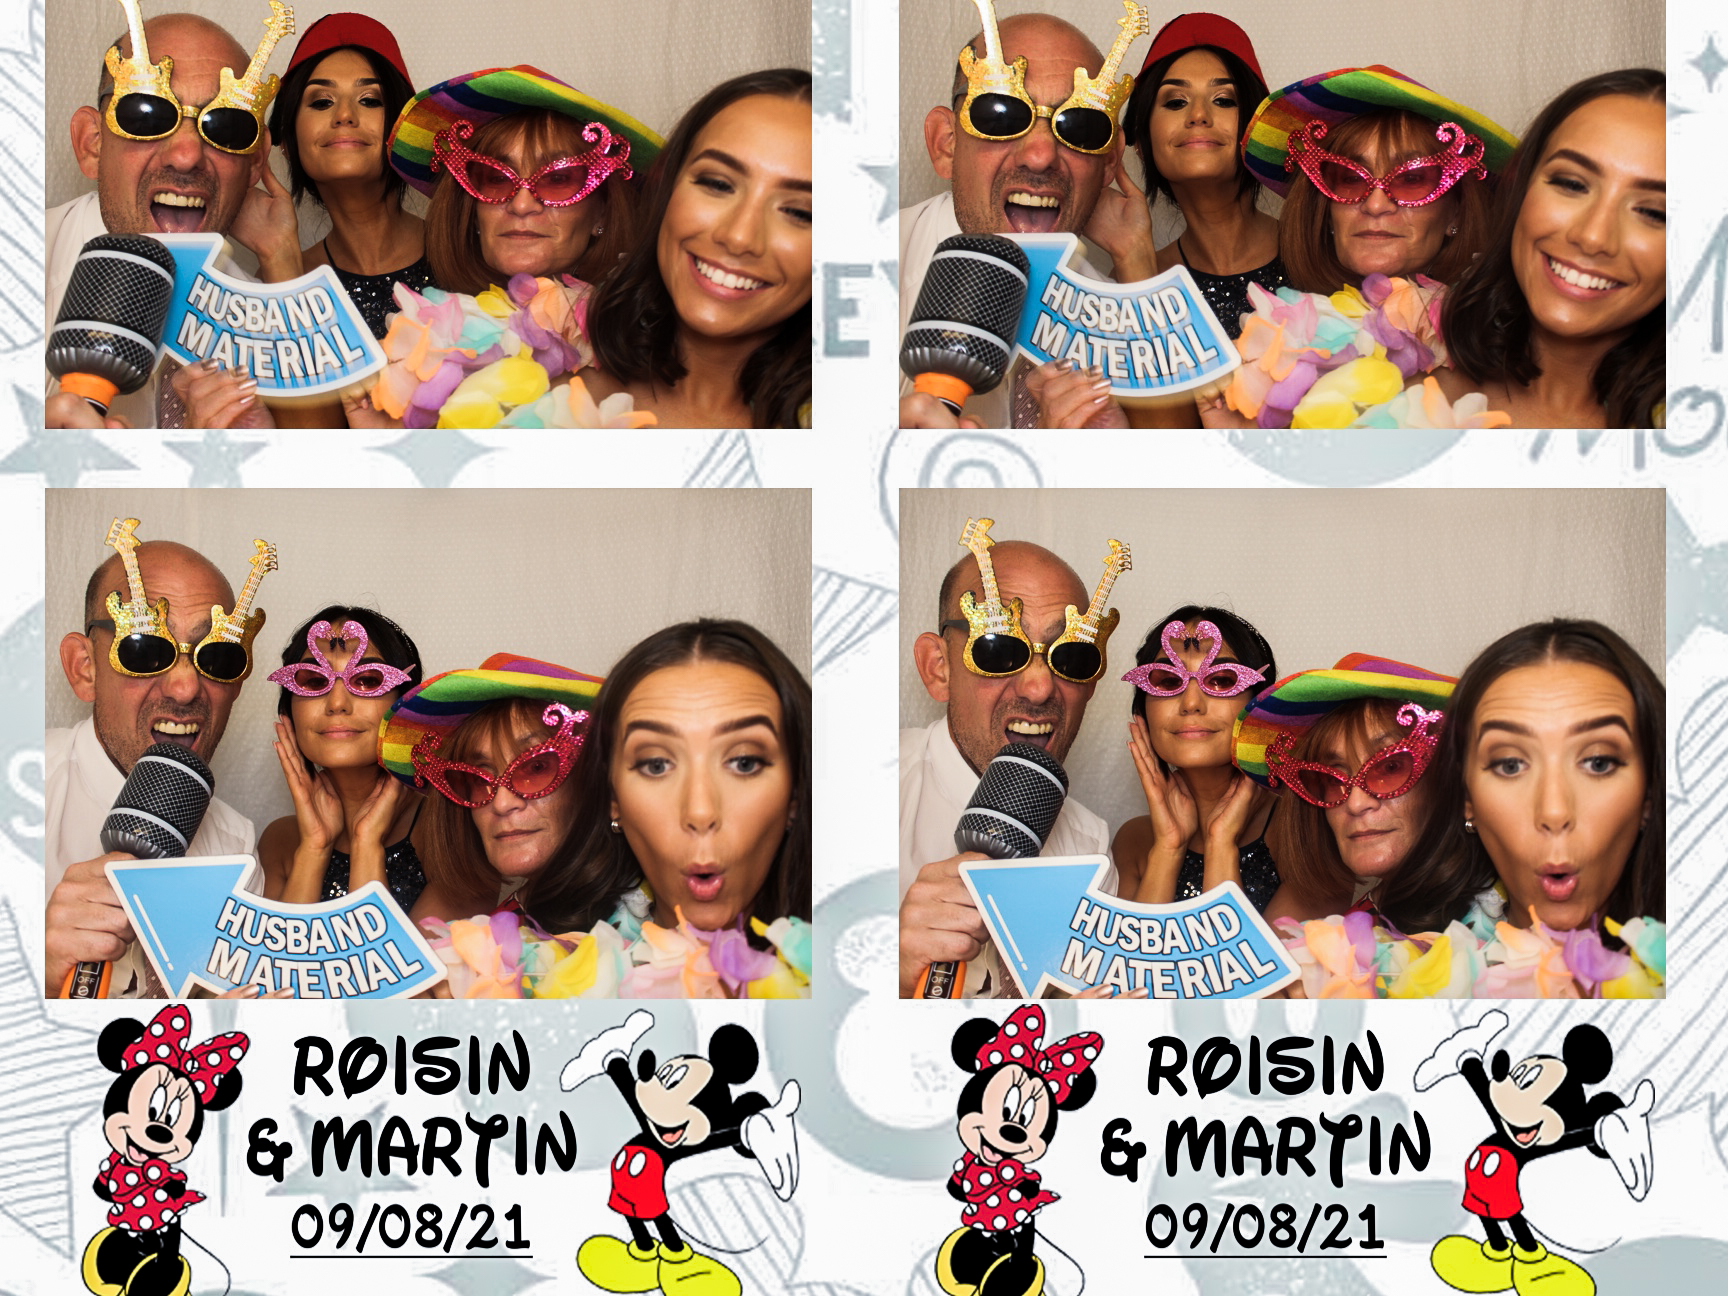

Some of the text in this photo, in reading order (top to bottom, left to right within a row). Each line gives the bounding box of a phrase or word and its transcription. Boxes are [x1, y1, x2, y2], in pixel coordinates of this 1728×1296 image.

[186, 272, 335, 334] HUSBAND
[1040, 272, 1189, 334] HUSBAND
[175, 310, 366, 380] MATERIAL
[1029, 310, 1220, 380] MATERIAL
[215, 896, 389, 956] HUSBAND
[1069, 896, 1243, 956] HUSBAND
[77, 975, 96, 985] OFF
[206, 936, 425, 999] MATERIAL
[931, 975, 950, 985] OFF
[1060, 936, 1279, 999] MATERIAL
